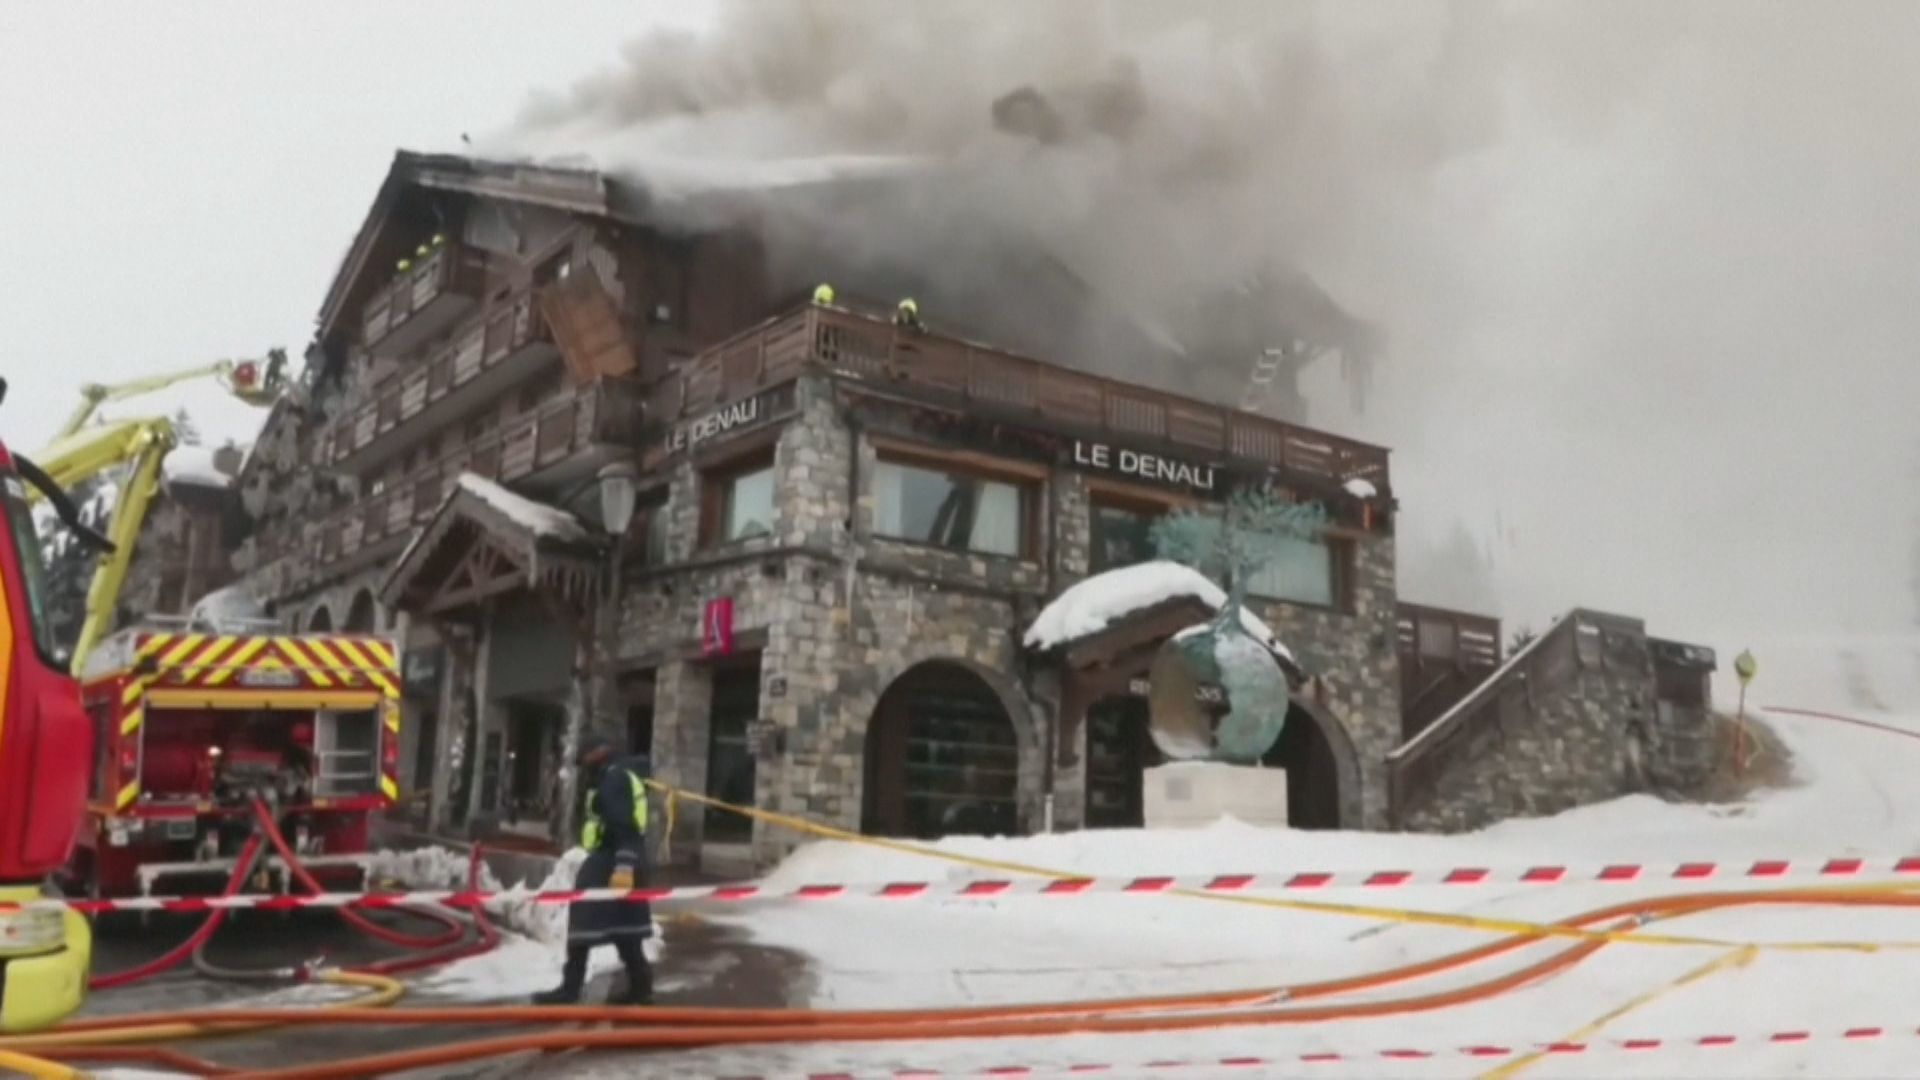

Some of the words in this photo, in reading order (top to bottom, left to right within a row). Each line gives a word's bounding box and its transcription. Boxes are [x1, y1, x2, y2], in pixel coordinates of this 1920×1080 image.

[664, 426, 686, 453] LE
[691, 397, 757, 443] DENALI
[1075, 440, 1110, 468] LE
[1119, 449, 1214, 489] DENALI
